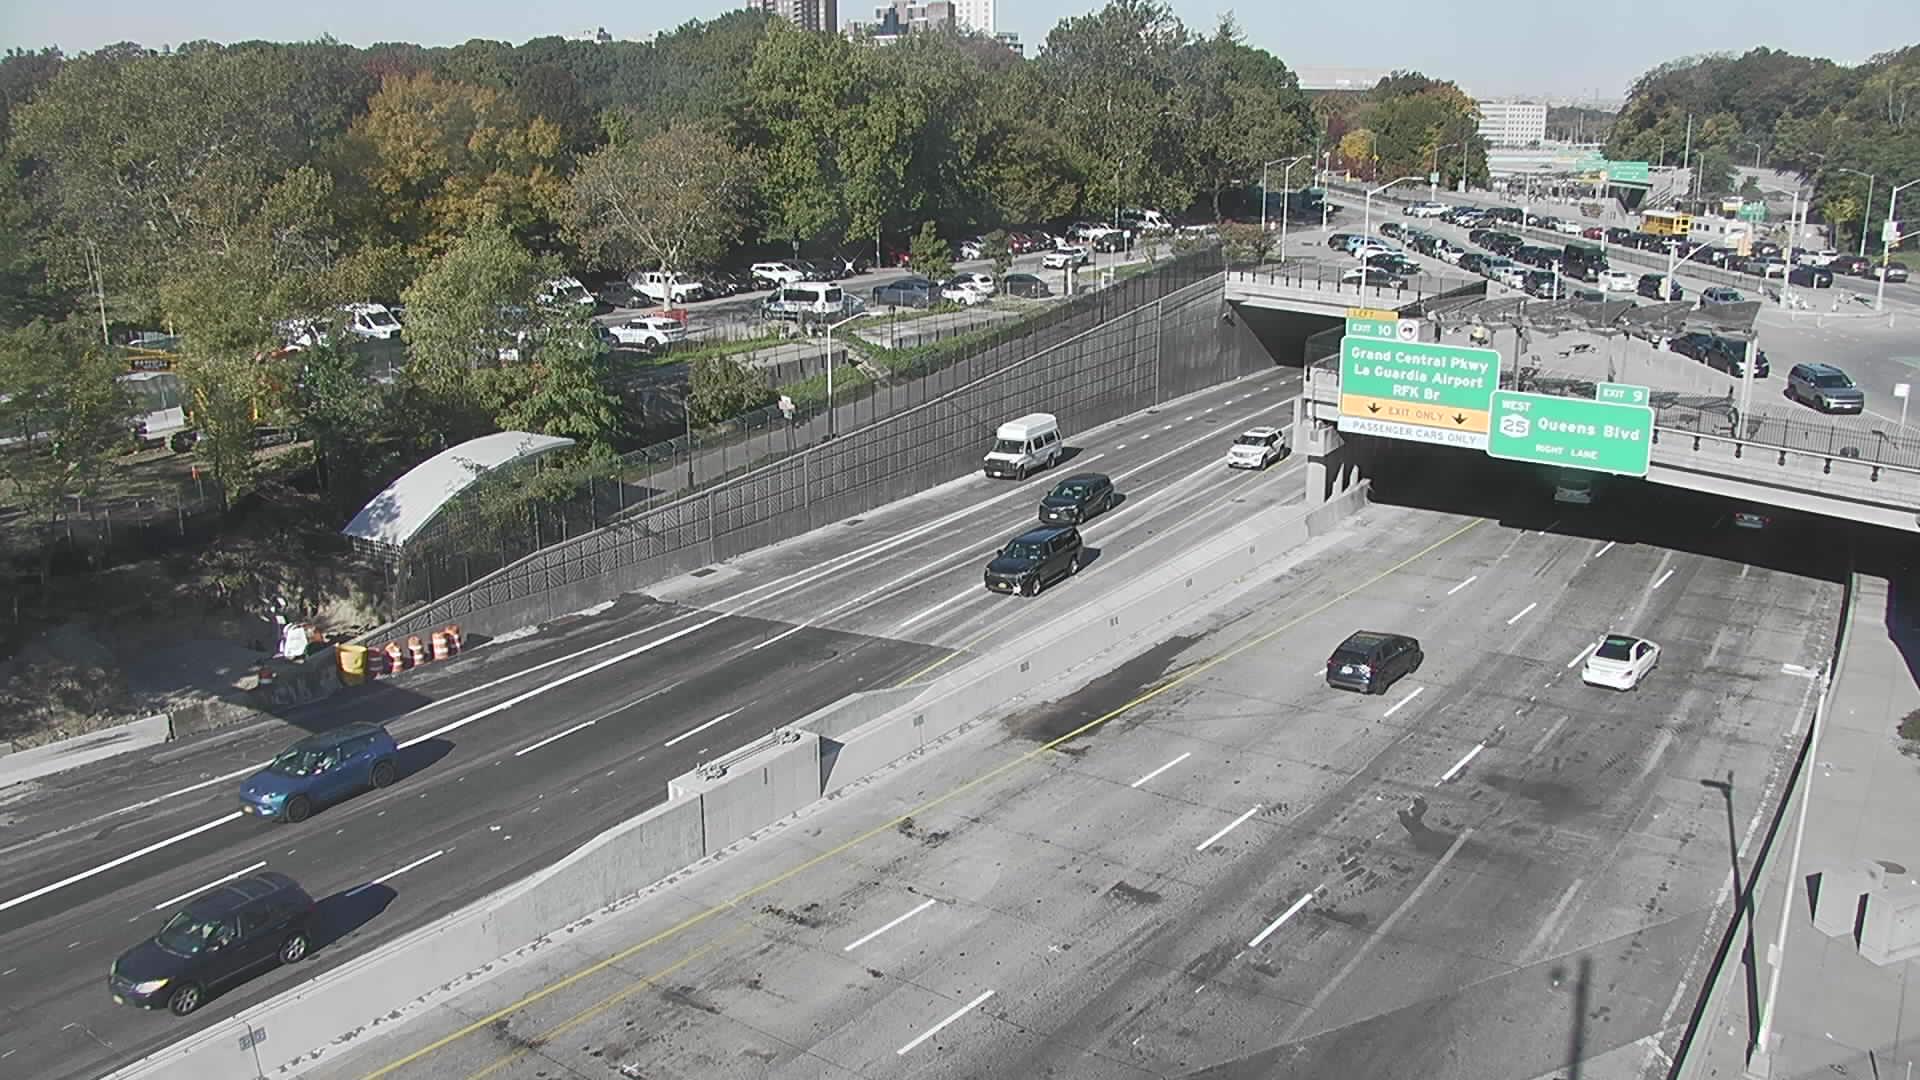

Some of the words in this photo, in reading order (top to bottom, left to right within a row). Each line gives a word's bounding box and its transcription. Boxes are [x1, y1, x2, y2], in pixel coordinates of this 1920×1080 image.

[1378, 325, 1391, 336] 10
[1351, 346, 1391, 362] Grand
[1395, 351, 1446, 368] Central
[1450, 357, 1488, 374] Pkwy
[1354, 364, 1370, 376] La
[1374, 365, 1427, 382] Guardia
[1432, 373, 1483, 389] Airport
[1392, 384, 1419, 399] RFK
[1424, 388, 1440, 400] Br
[1603, 388, 1624, 399] EXIT
[1633, 391, 1643, 402] 9
[1388, 406, 1409, 416] EXIT
[1415, 410, 1444, 421] ONLY
[1502, 400, 1532, 412] WEST
[1352, 421, 1414, 436] PASSENGER
[1416, 428, 1444, 441] CARS
[1447, 433, 1477, 445] ONLY
[1503, 418, 1528, 433] 25
[1537, 417, 1596, 436] Queens
[1603, 425, 1641, 441] Blvd
[1535, 444, 1564, 455] RIGHT
[1570, 449, 1599, 460] LANE
